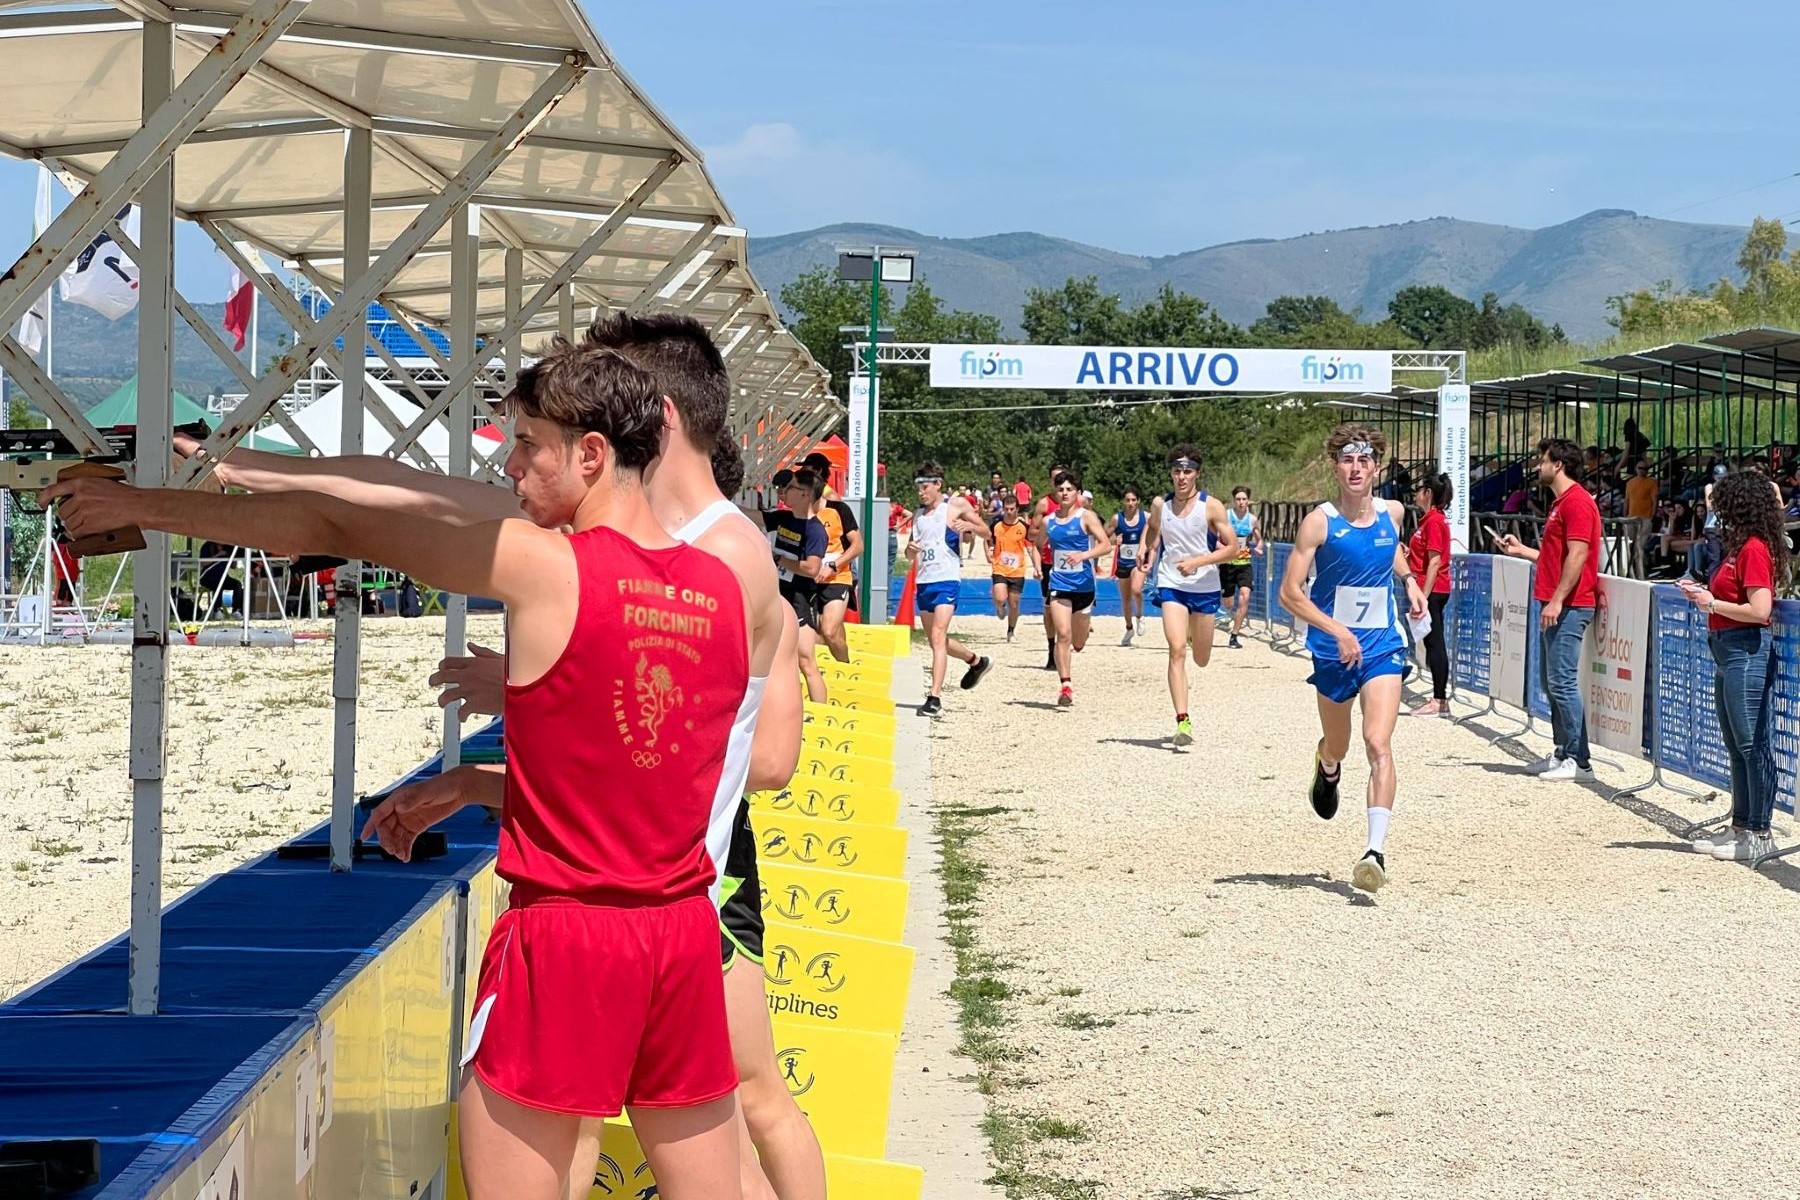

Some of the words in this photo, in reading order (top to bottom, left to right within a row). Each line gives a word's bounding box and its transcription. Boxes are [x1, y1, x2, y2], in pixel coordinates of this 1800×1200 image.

[1076, 351, 1239, 387] ARRIVO
[853, 419, 861, 457] Italiana
[1445, 427, 1454, 464] Italiana
[1457, 427, 1466, 471] Moderno
[1457, 473, 1466, 526] Pentathlon
[921, 548, 935, 562] 28
[1004, 557, 1016, 566] 37
[1059, 557, 1075, 570] 2
[681, 588, 719, 613] ORO
[1355, 601, 1371, 623] 7
[623, 603, 712, 640] FORCINITI
[628, 635, 664, 650] POLIZIA
[665, 637, 675, 648] DI
[676, 641, 702, 665] STATO
[613, 679, 634, 746] FIAMME
[445, 935, 451, 986] 6
[303, 1094, 311, 1161] 4
